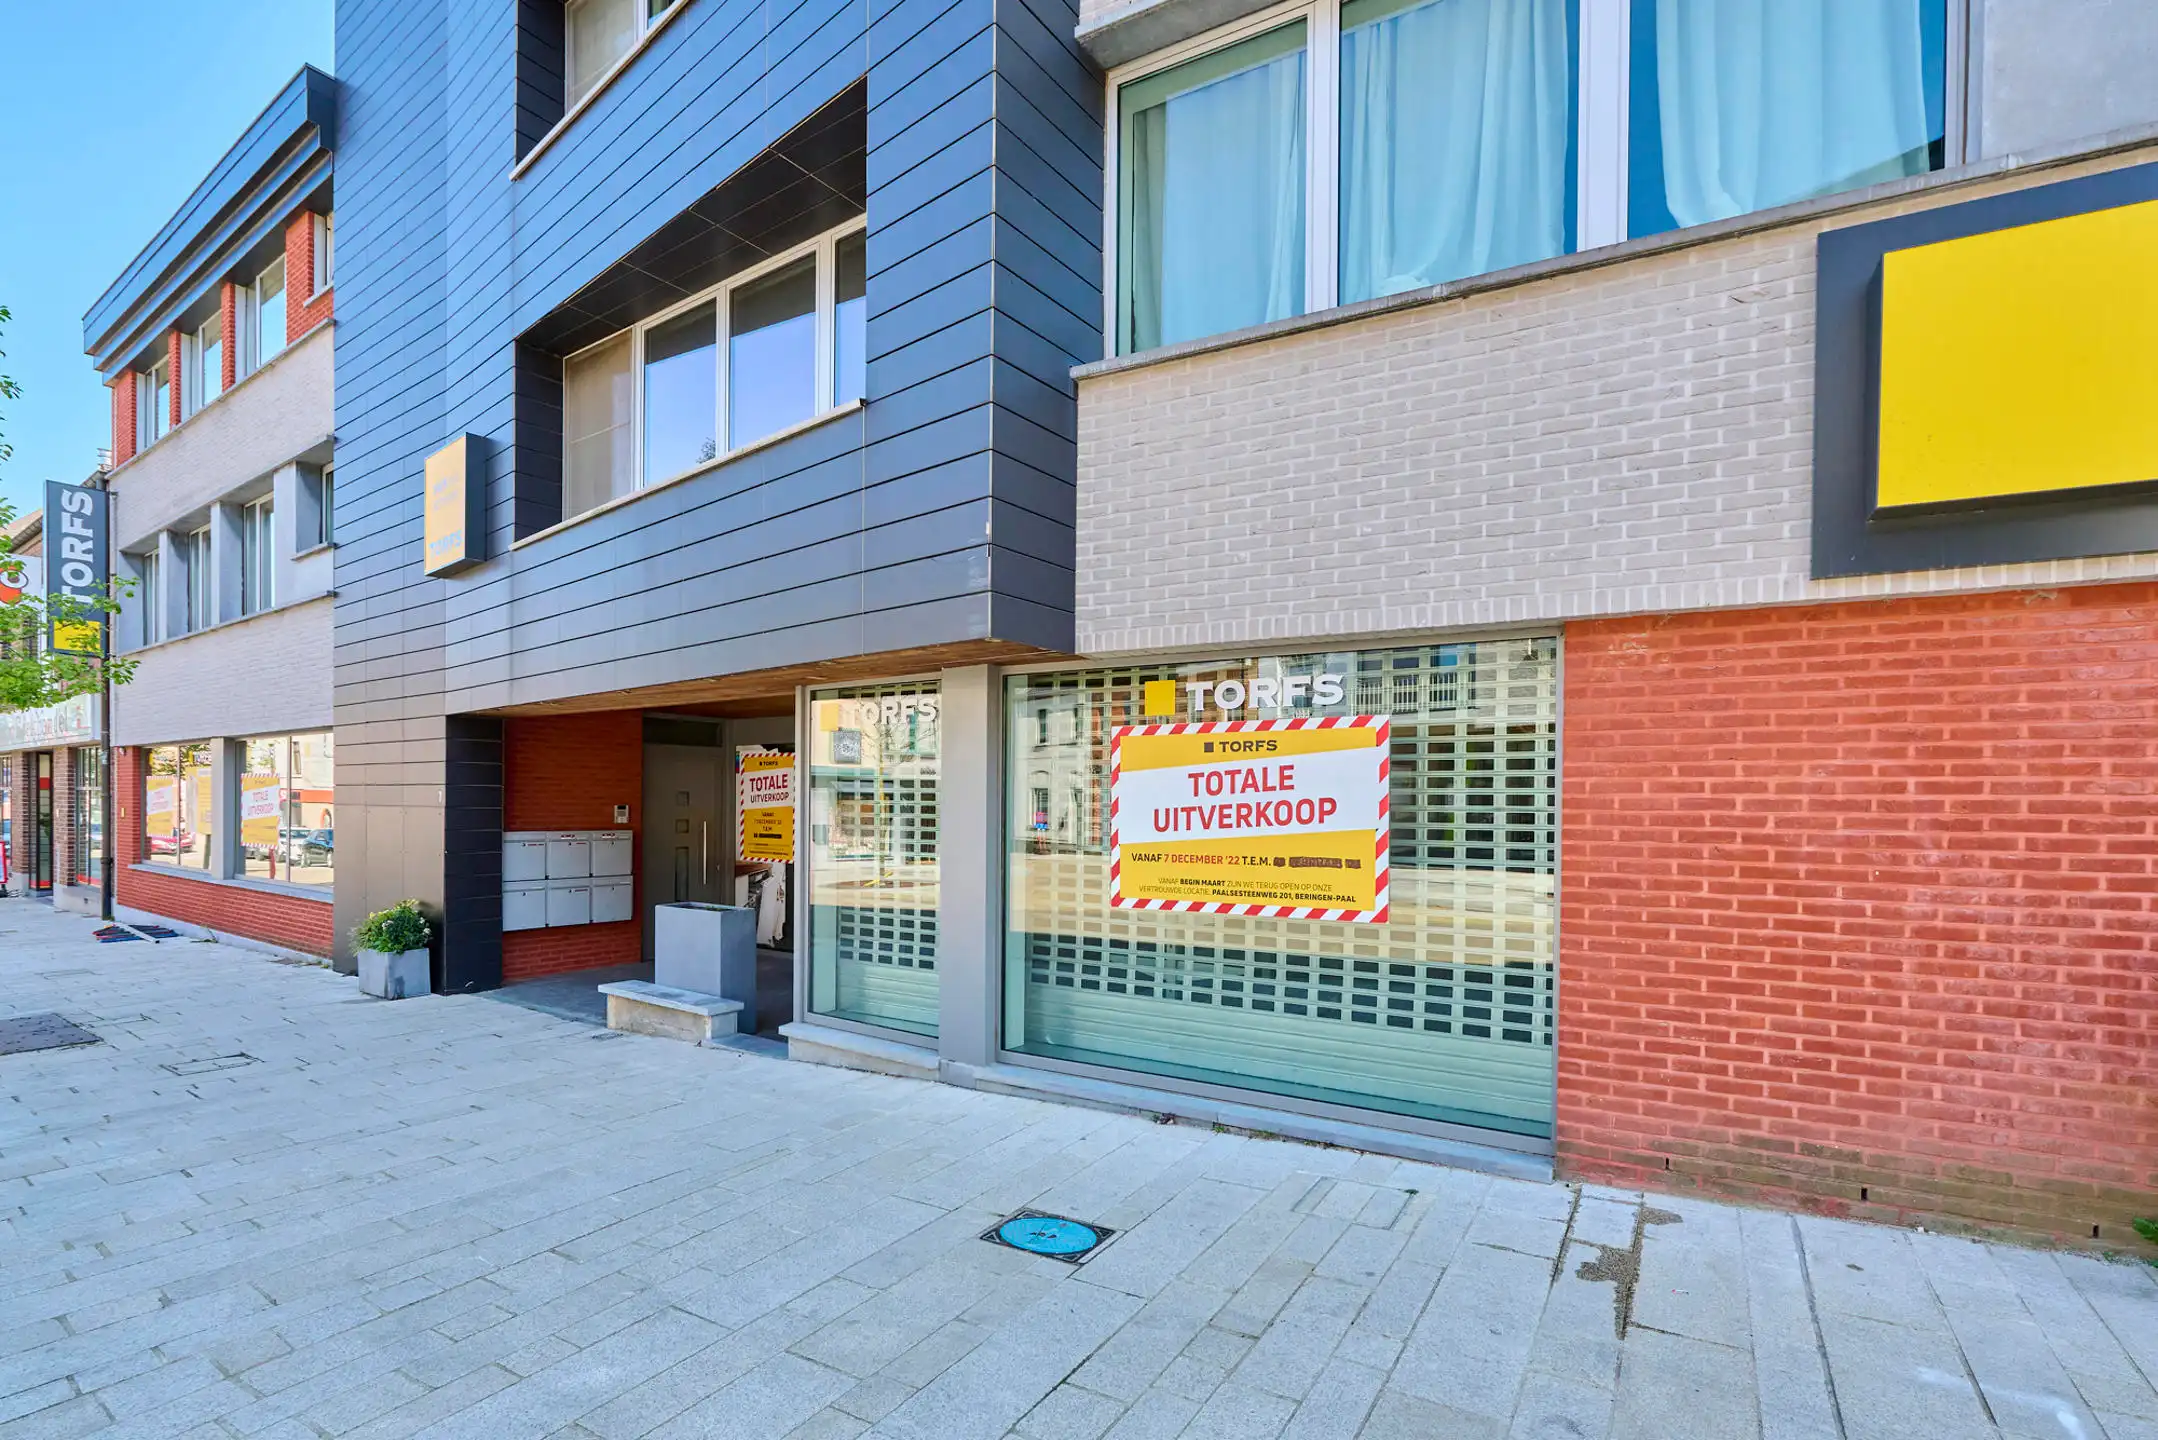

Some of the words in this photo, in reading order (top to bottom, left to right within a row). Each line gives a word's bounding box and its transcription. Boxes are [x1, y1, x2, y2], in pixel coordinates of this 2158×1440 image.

[61, 487, 93, 605] TORFS
[1185, 673, 1344, 712] TORFS
[1219, 739, 1278, 753] TORFS
[749, 773, 788, 792] TOTALE
[1187, 764, 1295, 798] TOTALE
[750, 791, 790, 803] UITVERKOOP
[1153, 796, 1338, 833] UITVERKOOP
[1131, 852, 1163, 863] VANAF
[1163, 853, 1170, 863] 7
[1171, 854, 1223, 865] DECEMBER
[1242, 856, 1271, 866] T.E.M.
[1158, 877, 1179, 886] VANAF
[1180, 878, 1200, 886] BEGIN
[1256, 881, 1279, 890] TERUG
[1281, 882, 1300, 891] OPEN
[1301, 883, 1312, 891] OP
[1212, 888, 1278, 899] PAALSESTEENWEG
[1295, 893, 1356, 903] BERINGEN-PAAL
